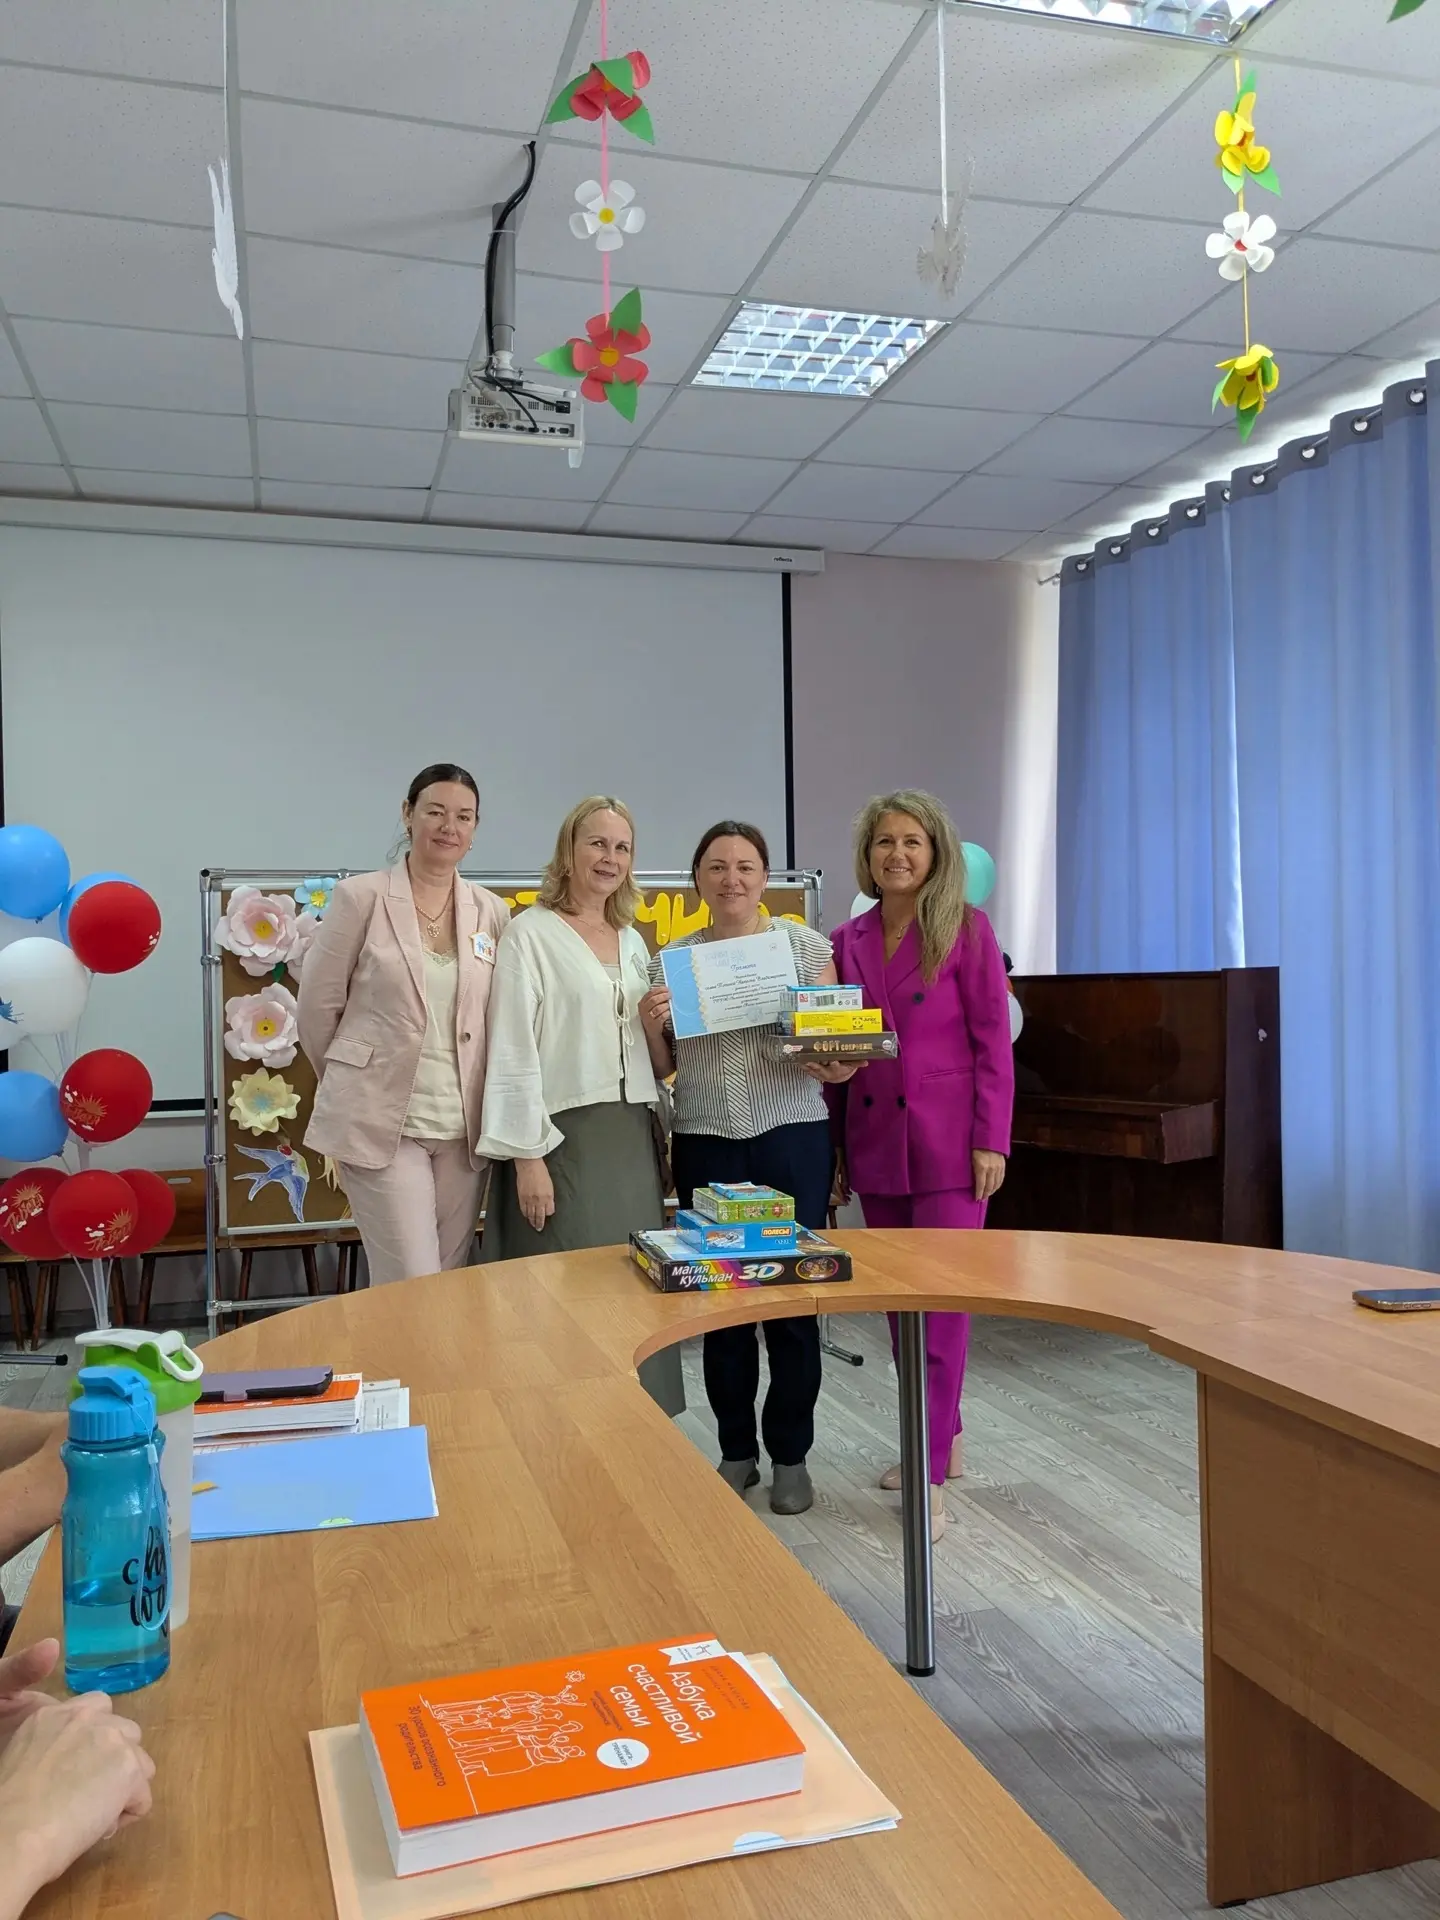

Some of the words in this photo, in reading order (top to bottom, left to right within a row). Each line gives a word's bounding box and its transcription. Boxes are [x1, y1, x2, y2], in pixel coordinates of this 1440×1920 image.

[738, 1263, 785, 1281] 3D
[408, 1705, 422, 1716] 30
[609, 1685, 652, 1727] семьи
[627, 1663, 703, 1744] счастливой
[665, 1671, 716, 1720] Азбука
[396, 1722, 423, 1770] родительства
[408, 1715, 429, 1739] уроков
[421, 1738, 446, 1787] осознанного
